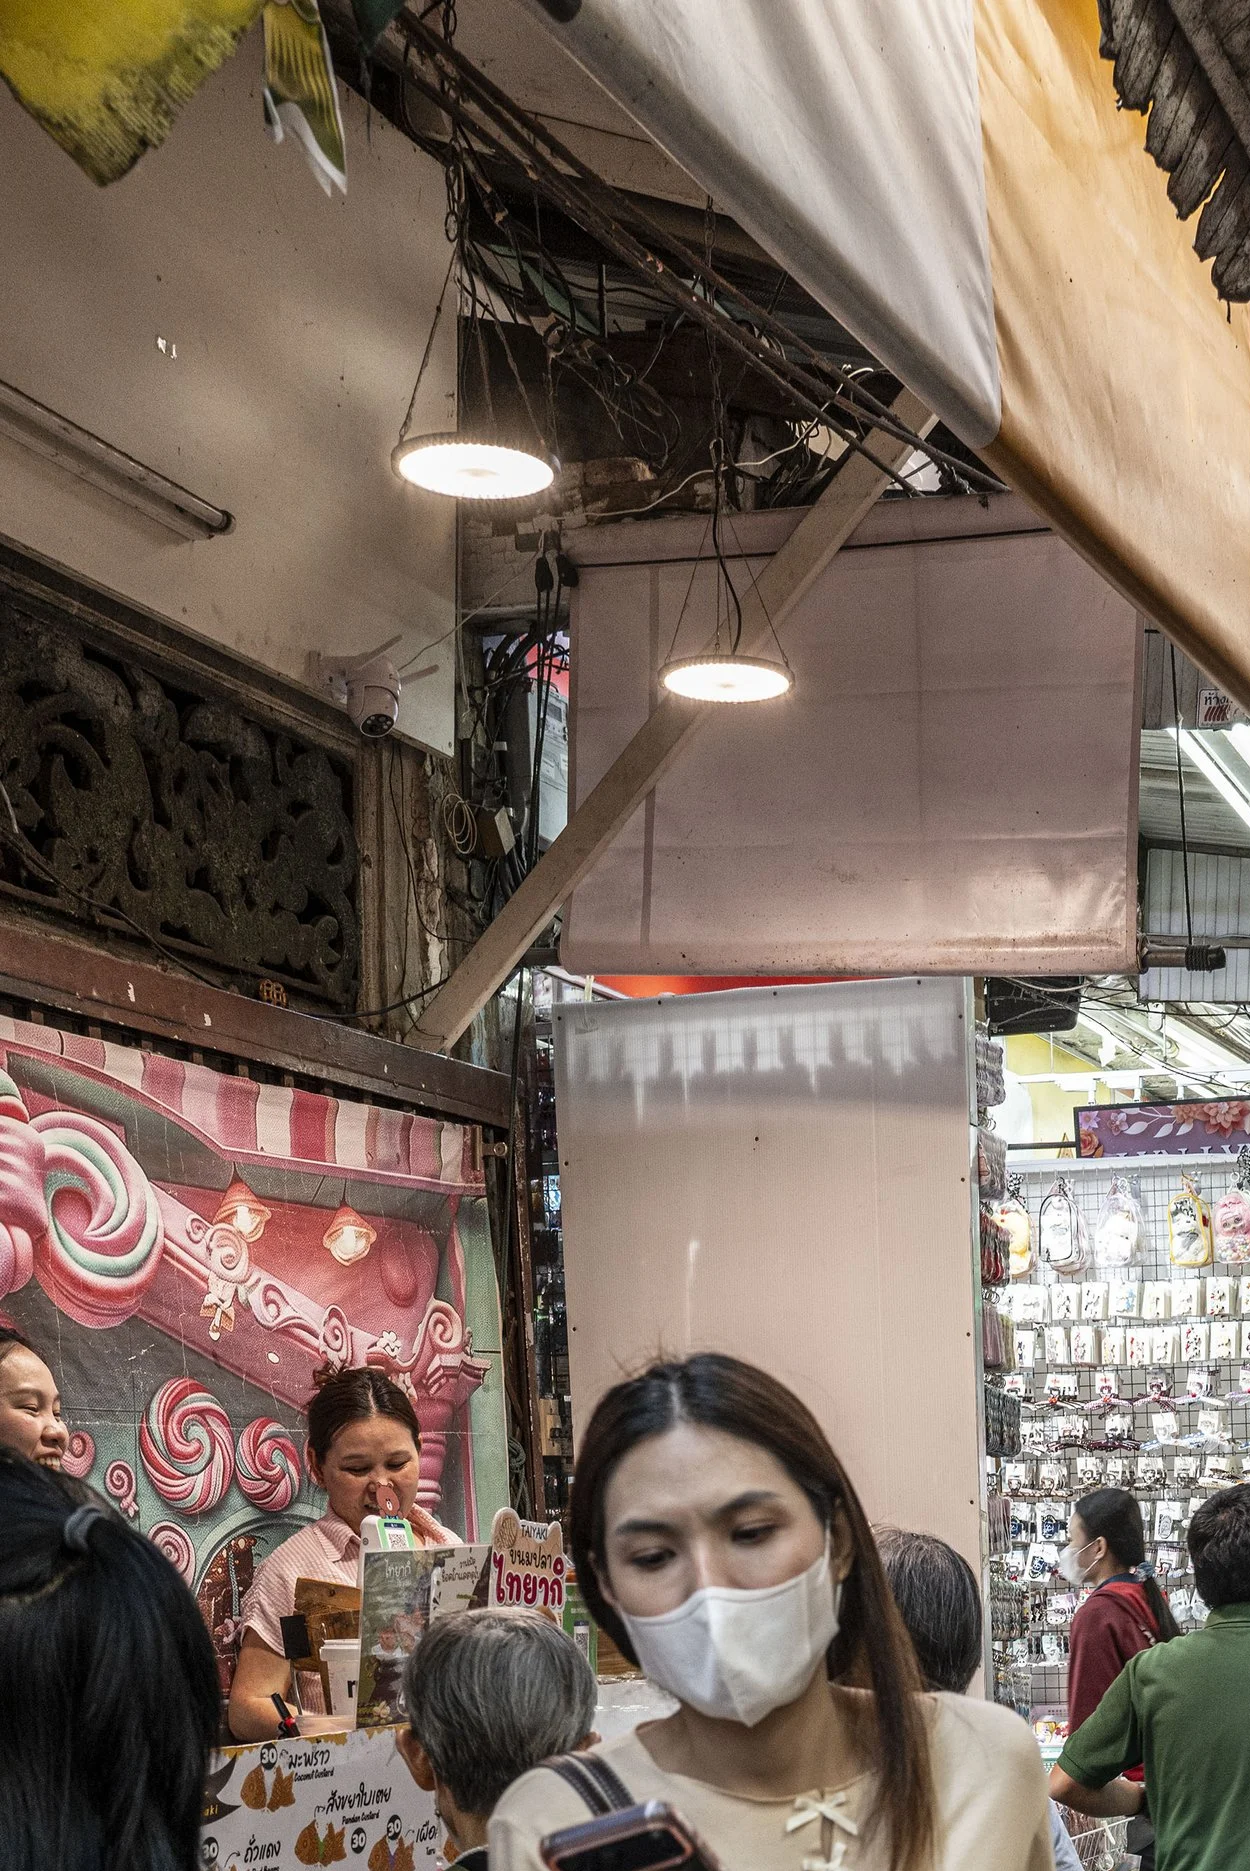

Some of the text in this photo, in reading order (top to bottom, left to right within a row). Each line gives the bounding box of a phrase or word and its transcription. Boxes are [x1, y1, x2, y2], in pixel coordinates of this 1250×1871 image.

[520, 1523, 549, 1541] TAIYAKI
[509, 1545, 553, 1570] ขนมปลา
[261, 1748, 277, 1765] 30
[294, 1766, 335, 1783] Coconut Custard
[325, 1781, 392, 1815] สังขยาใบเตย
[341, 1809, 381, 1826] Pandan Custard
[386, 1818, 402, 1838] 30
[244, 1833, 281, 1864] ถั่วแดง
[351, 1832, 366, 1850] 30
[201, 1842, 218, 1860] 30
